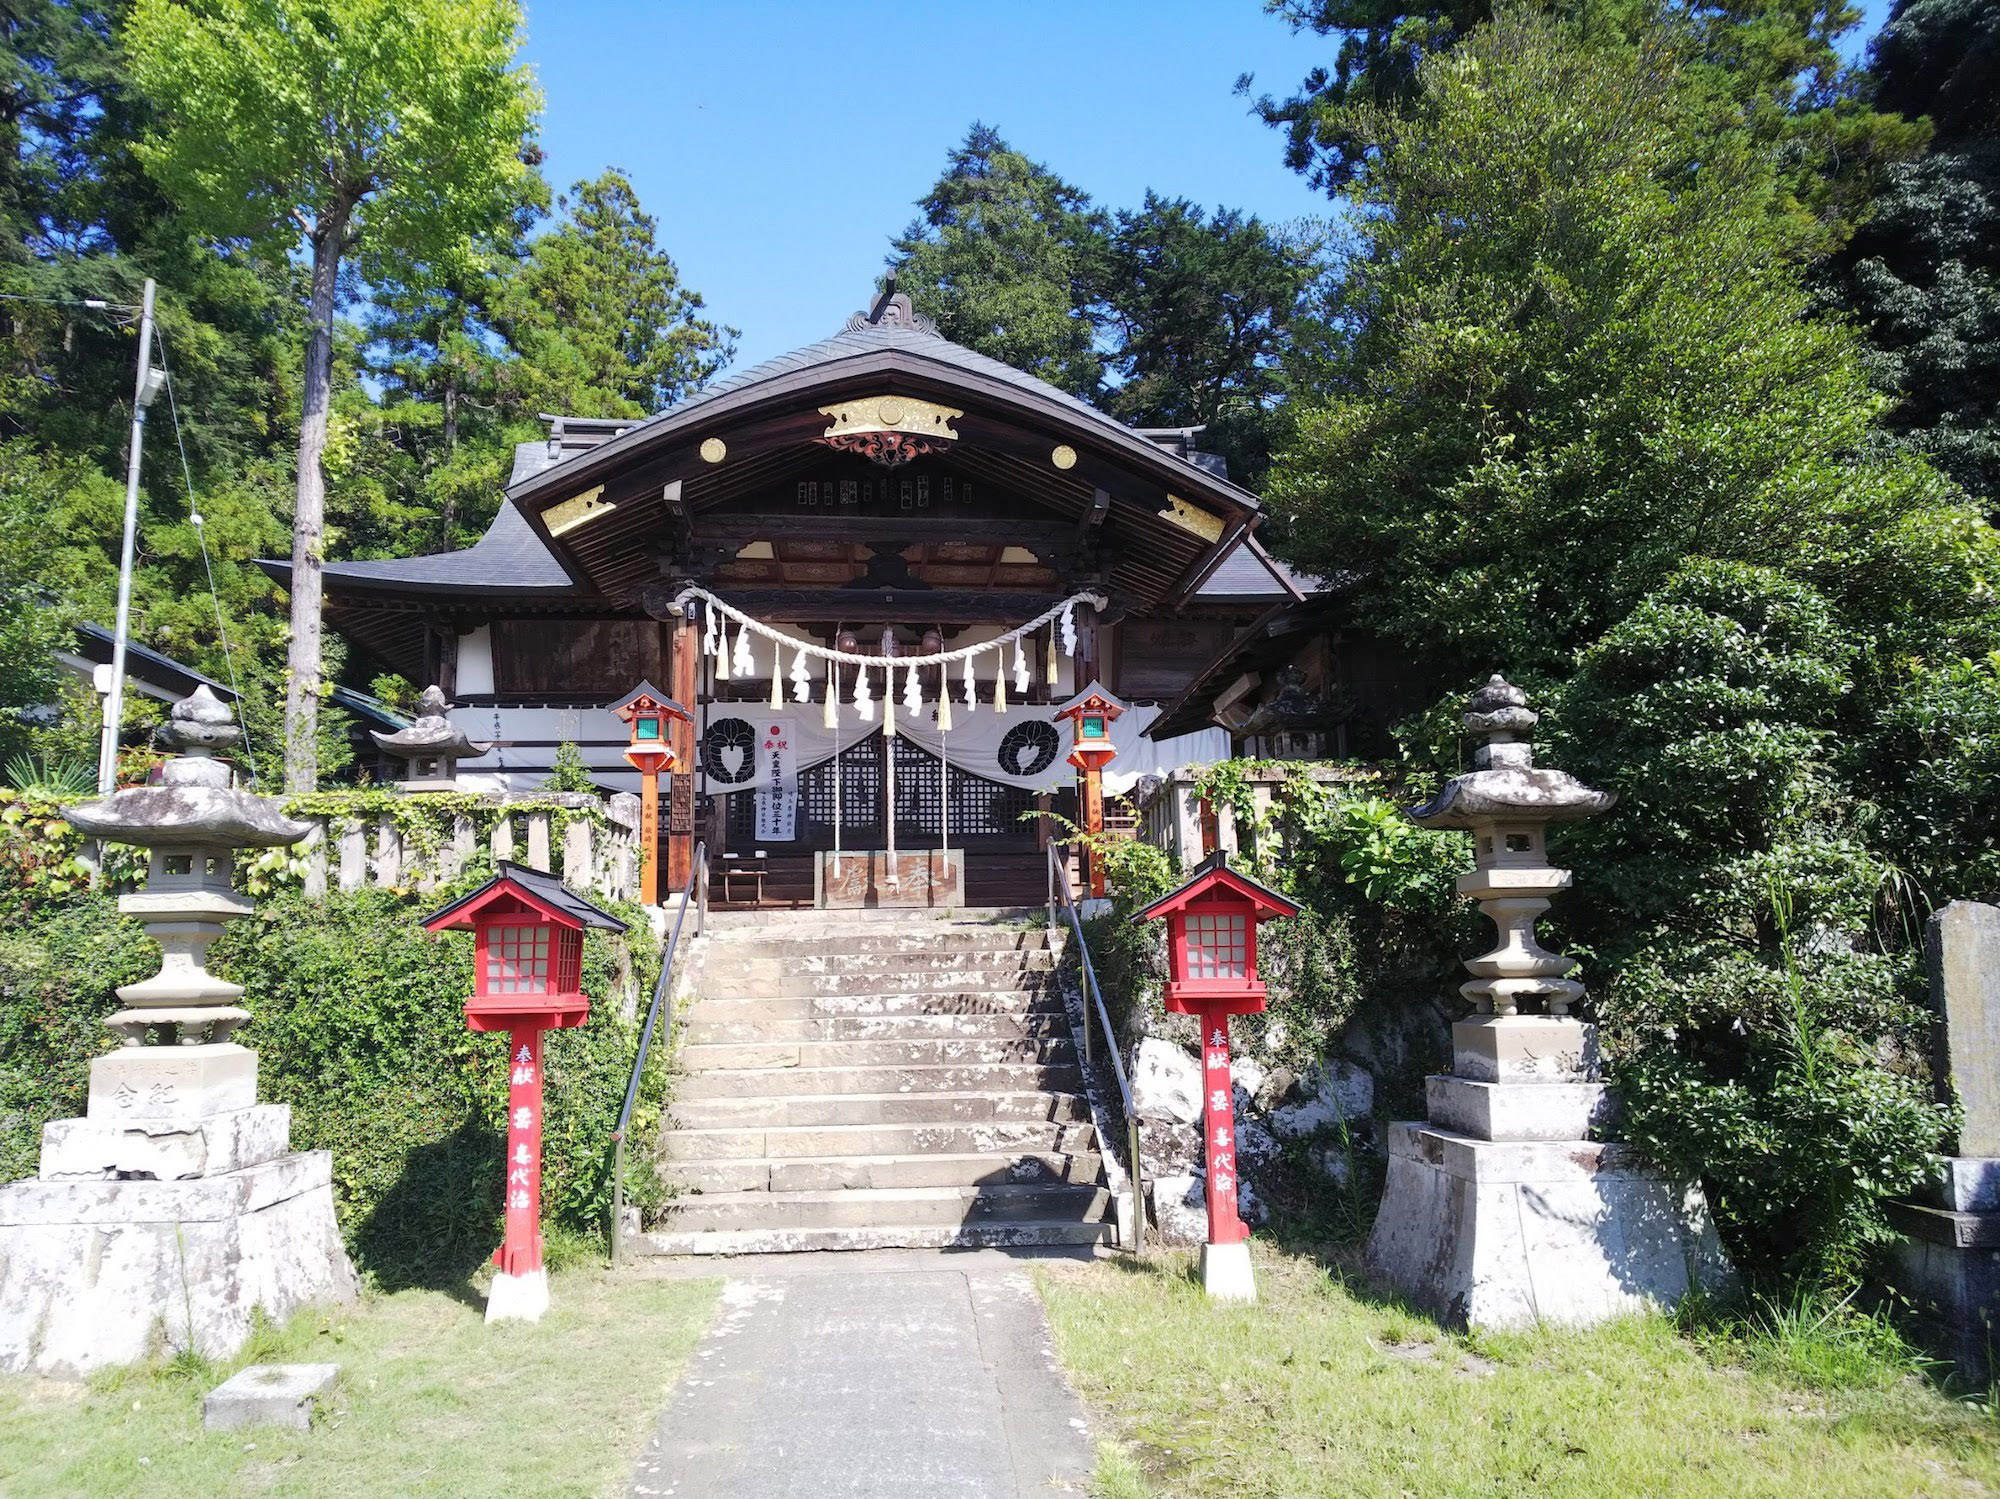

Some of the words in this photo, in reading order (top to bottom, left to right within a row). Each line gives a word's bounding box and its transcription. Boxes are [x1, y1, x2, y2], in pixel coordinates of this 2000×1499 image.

[763, 740, 789, 750] 奉祝
[771, 750, 783, 836] 天皇陛下御即位三十年
